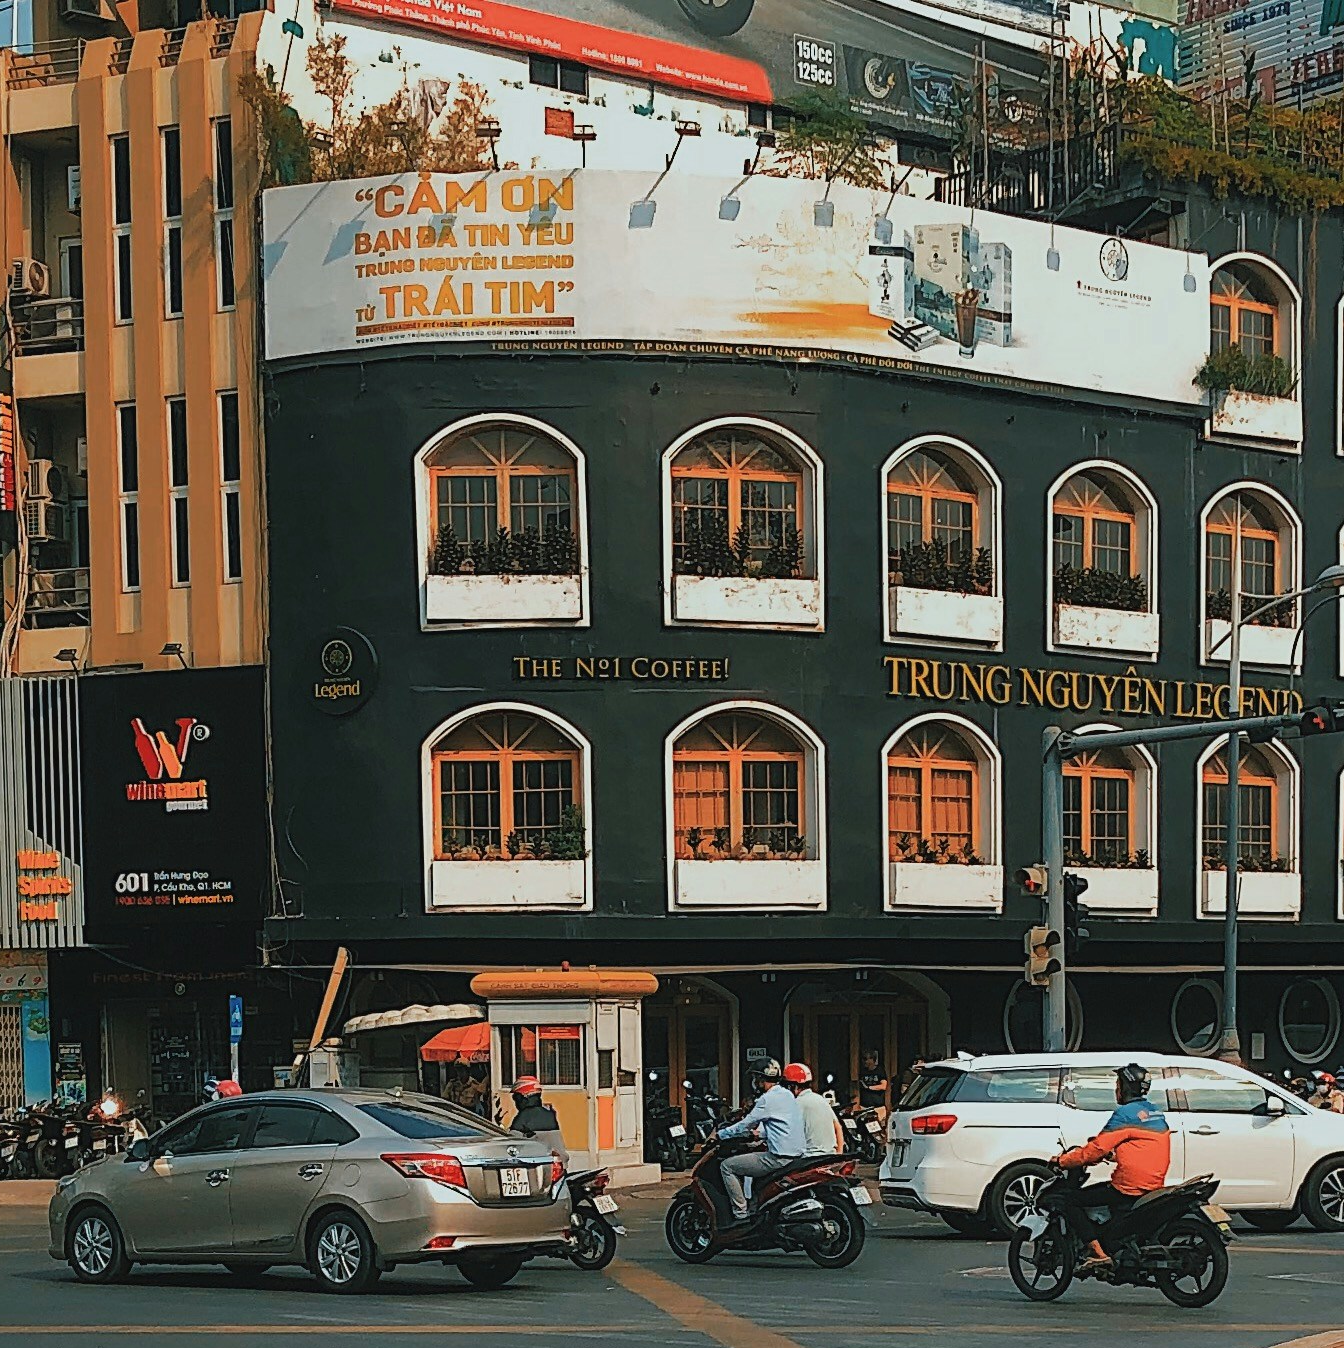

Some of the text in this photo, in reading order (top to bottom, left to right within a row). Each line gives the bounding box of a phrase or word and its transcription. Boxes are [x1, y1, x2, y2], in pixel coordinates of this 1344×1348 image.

[457, 3, 482, 19] Nam
[797, 40, 833, 65] 150cc
[797, 61, 833, 86] 125cc
[501, 175, 574, 212] ƠN
[355, 216, 574, 257] BẠN ĐÃ TIN YÊU
[355, 252, 574, 279] TRUNG NGUYÊN LEGEND
[379, 275, 474, 318] TRÁI
[491, 342, 529, 350] TRUNG
[581, 342, 624, 350] LEGEND
[513, 656, 562, 678] THE
[315, 680, 360, 699] Legend
[883, 656, 1011, 704] TRUNG
[1019, 665, 1167, 715] NGUYÊN
[126, 780, 208, 801] winemart
[17, 850, 61, 870] Wine
[18, 876, 72, 898] Spirits
[115, 872, 149, 893] 601
[154, 871, 208, 881] Trần Hưng Đạo
[212, 881, 231, 890] HCM
[178, 894, 233, 905] winemart.vn
[19, 900, 59, 922] Food
